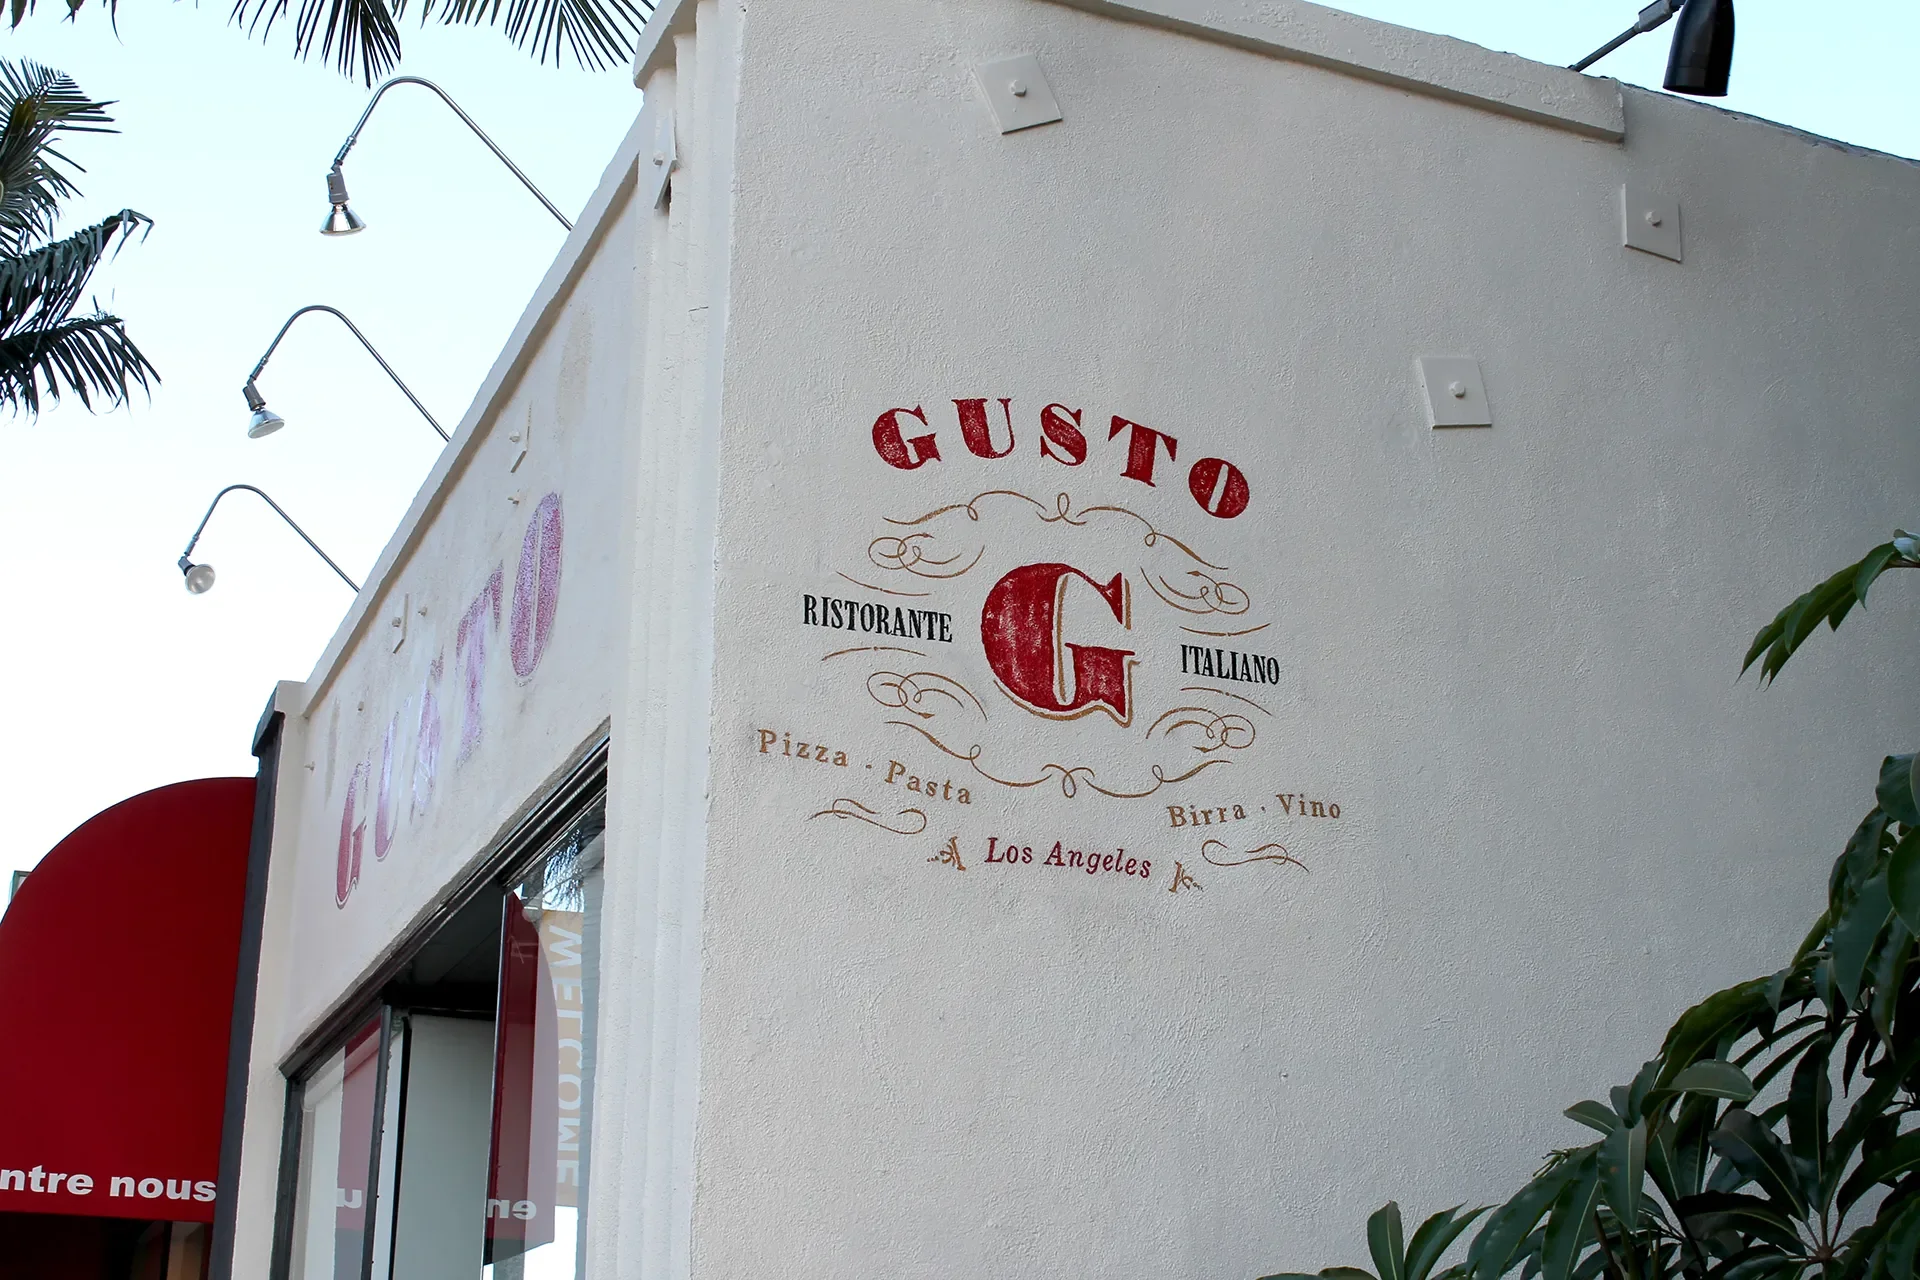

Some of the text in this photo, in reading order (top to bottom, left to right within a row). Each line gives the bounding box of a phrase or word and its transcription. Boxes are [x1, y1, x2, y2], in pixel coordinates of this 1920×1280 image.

[872, 397, 1250, 519] GUSTO
[803, 594, 953, 643] RISTORANTE
[981, 562, 1141, 728] G
[1180, 644, 1280, 685] ITALIANO
[757, 729, 972, 804] Pizza Pasta
[1166, 793, 1341, 828] Birra Vino
[984, 836, 1152, 878] Los Angeles
[0, 1165, 217, 1202] ntre nous
